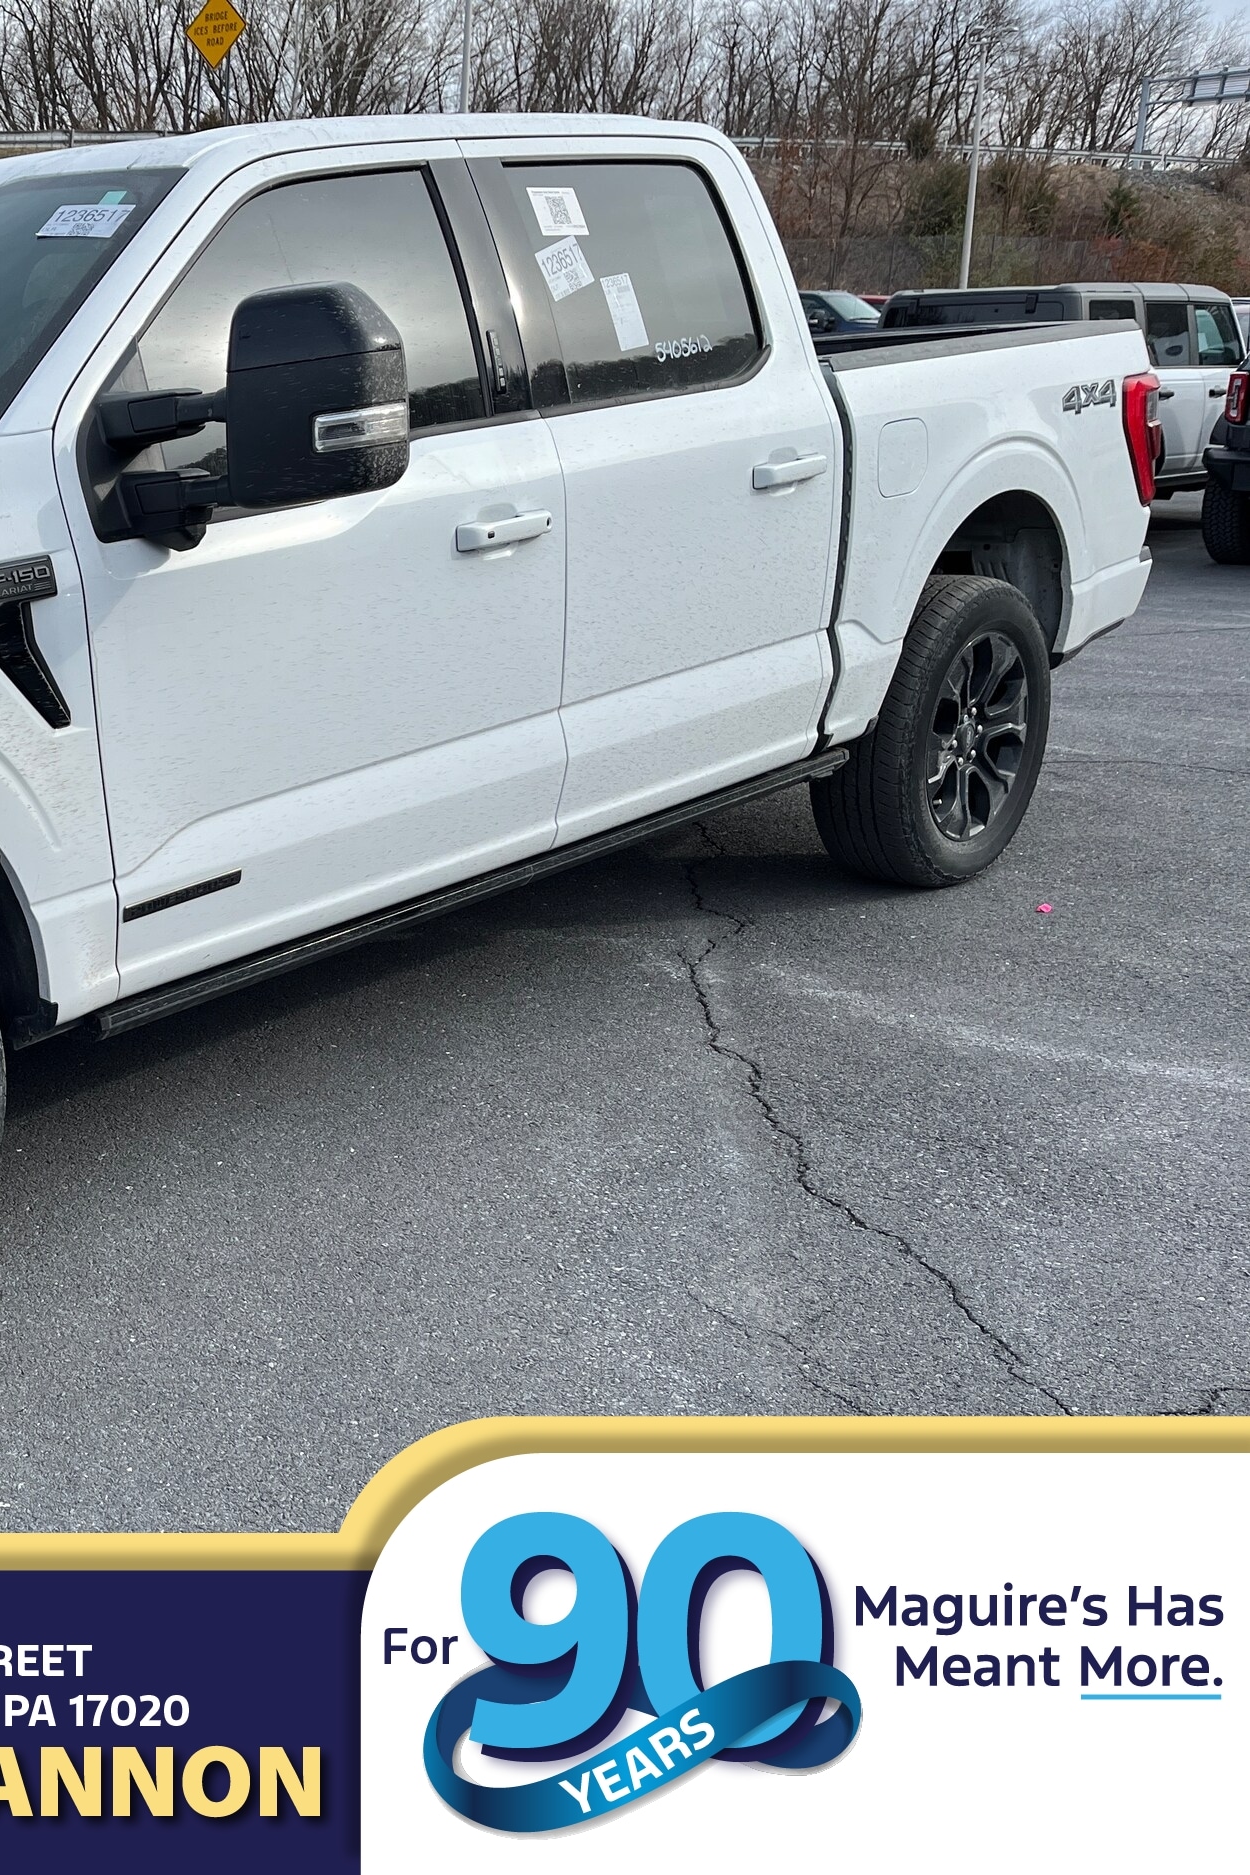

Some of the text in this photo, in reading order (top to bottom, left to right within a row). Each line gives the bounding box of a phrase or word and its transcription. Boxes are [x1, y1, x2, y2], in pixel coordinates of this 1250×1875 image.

[205, 11, 228, 21] BRIDGE
[194, 22, 237, 35] ICES BEFORE
[206, 37, 224, 46] ROAD
[54, 209, 131, 223] 1236517
[541, 243, 583, 277] 1236517
[654, 334, 713, 363] 5405612
